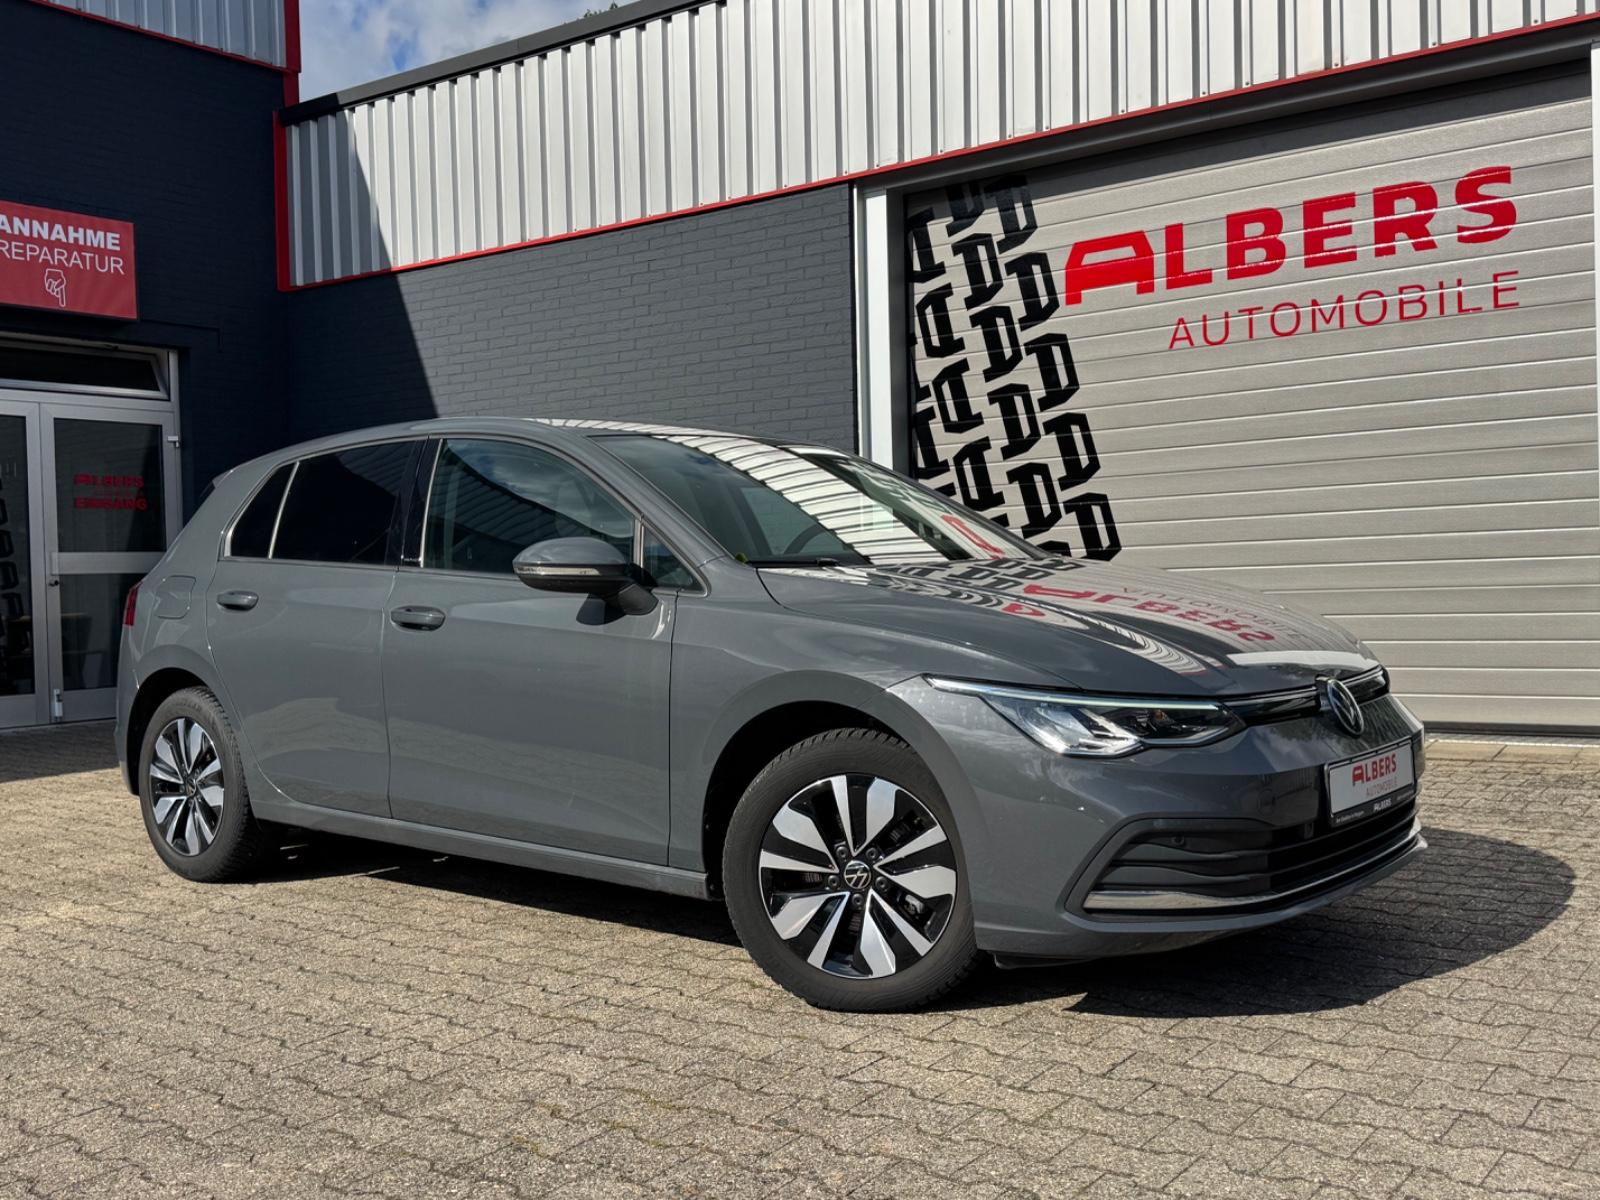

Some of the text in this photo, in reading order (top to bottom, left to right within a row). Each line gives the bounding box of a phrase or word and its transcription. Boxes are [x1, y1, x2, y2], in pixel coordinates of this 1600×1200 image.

[0, 213, 121, 251] ANNAHME
[1064, 165, 1517, 306] ALBERS
[0, 239, 125, 275] REPARATUR
[1168, 270, 1521, 350] AUTOMOBILE
[75, 496, 148, 511] EINGANG
[1352, 752, 1397, 787] ALBERS
[1366, 776, 1398, 797] AUTOMOBILE
